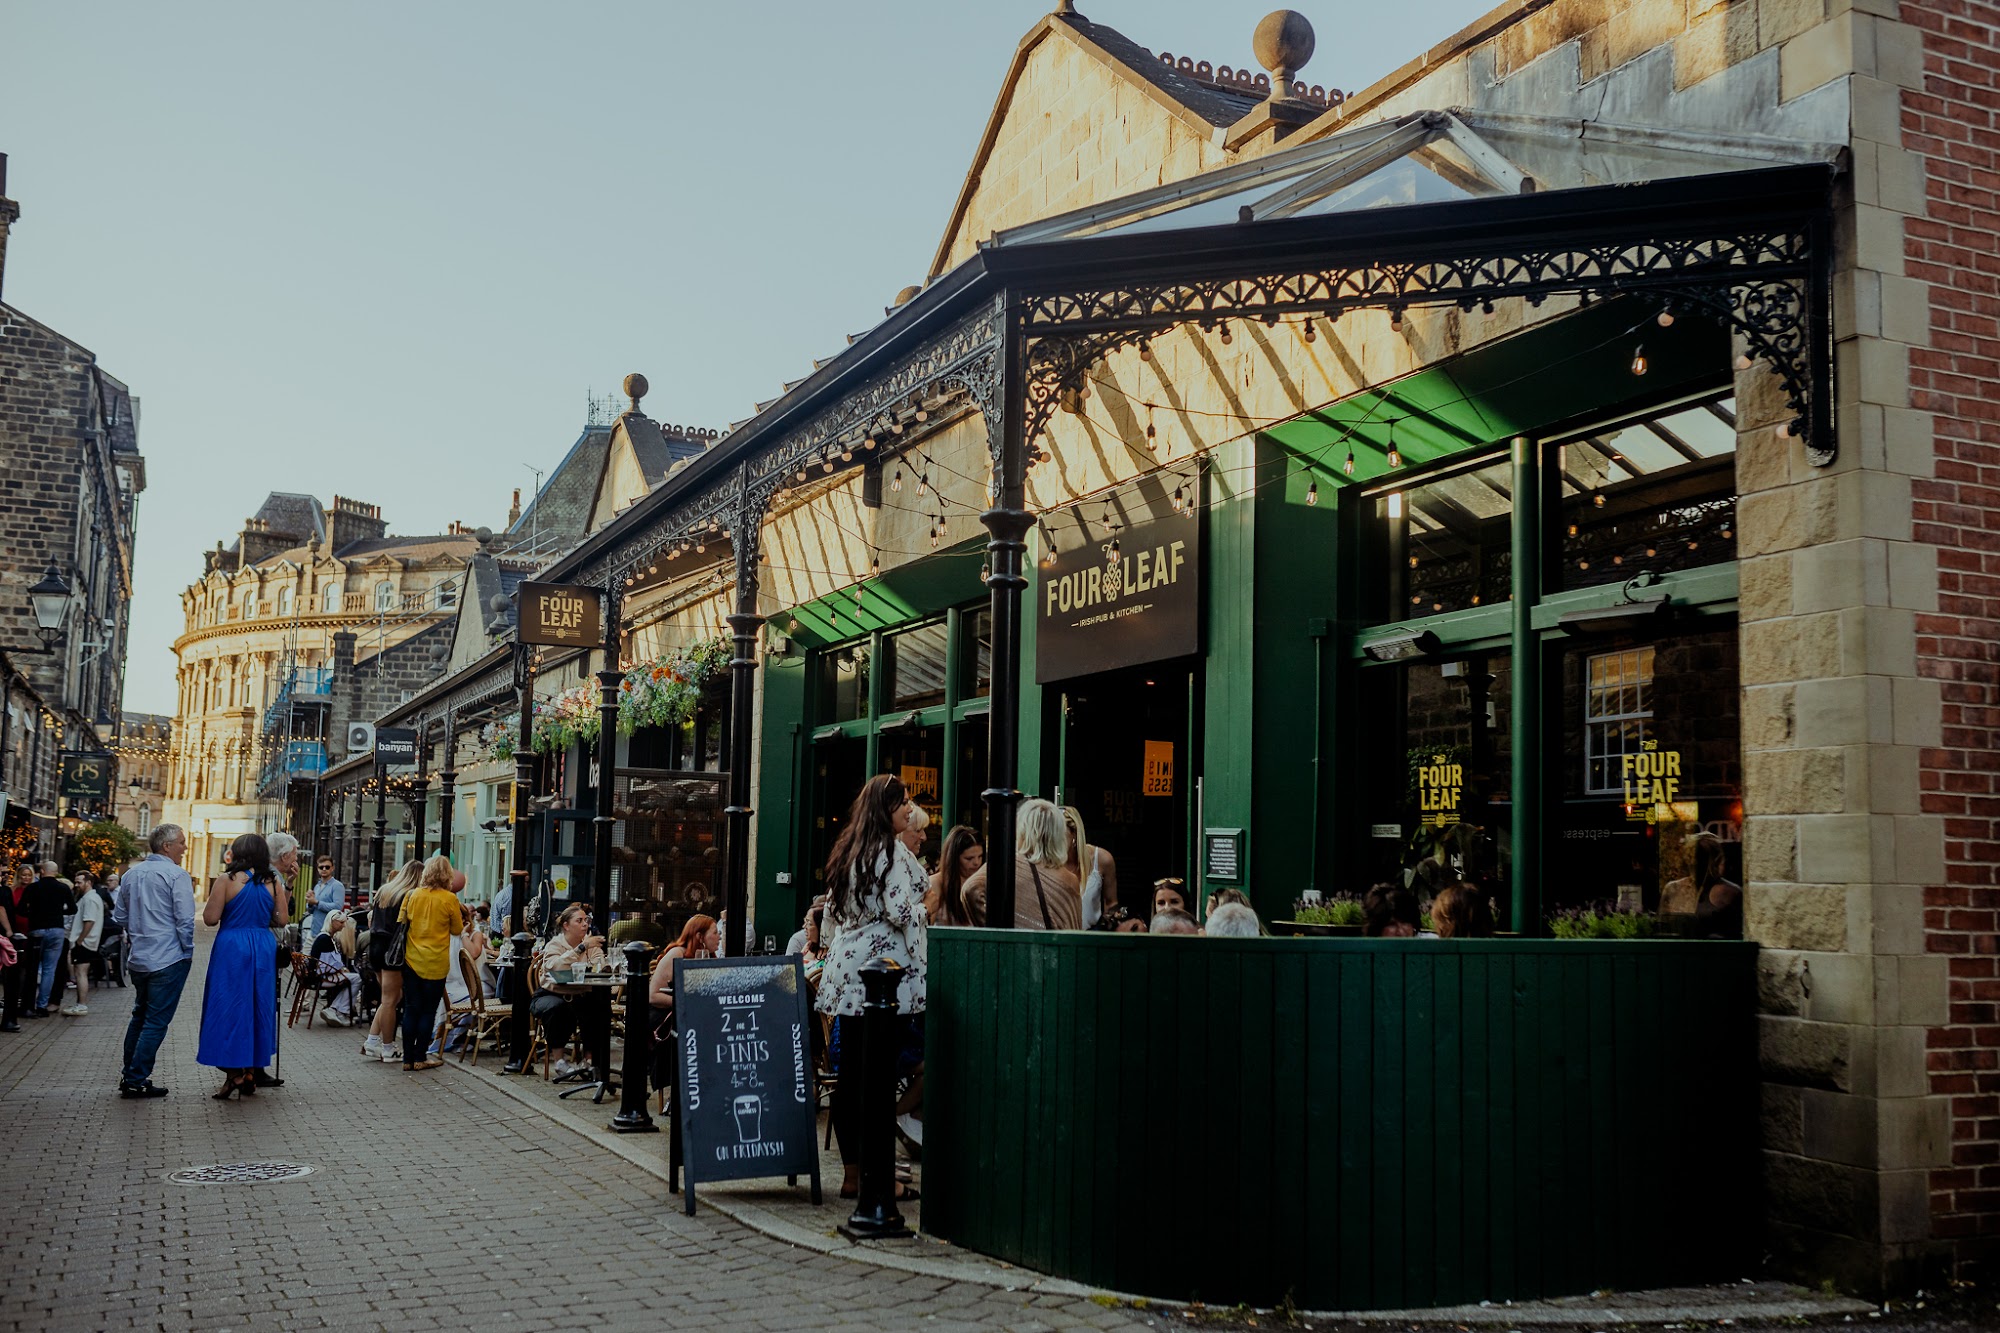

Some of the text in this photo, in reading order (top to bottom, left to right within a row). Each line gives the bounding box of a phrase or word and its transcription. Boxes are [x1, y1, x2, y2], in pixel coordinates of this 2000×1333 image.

[1047, 540, 1185, 617] FOUR LEAF
[540, 596, 583, 614] FOUR
[1079, 603, 1144, 627] IRISH PUB & KITCHEN
[541, 611, 582, 628] LEAF
[379, 742, 412, 753] banyan
[71, 763, 99, 783] PS
[1623, 751, 1681, 778] FOUR
[1419, 764, 1462, 788] FOUR
[1420, 788, 1461, 811] LEAF
[1625, 778, 1680, 804] LEAF
[718, 994, 765, 1005] WELCOME
[721, 1012, 731, 1032] 2
[748, 1011, 759, 1031] 1
[735, 1033, 745, 1041] ALL
[716, 1040, 769, 1063] PINTS
[686, 1029, 701, 1110] GUINNESS
[732, 1062, 757, 1071] BETWEEN
[791, 1023, 806, 1103] GUINNESS
[716, 1141, 784, 1160] ON FRIDAYS!!
